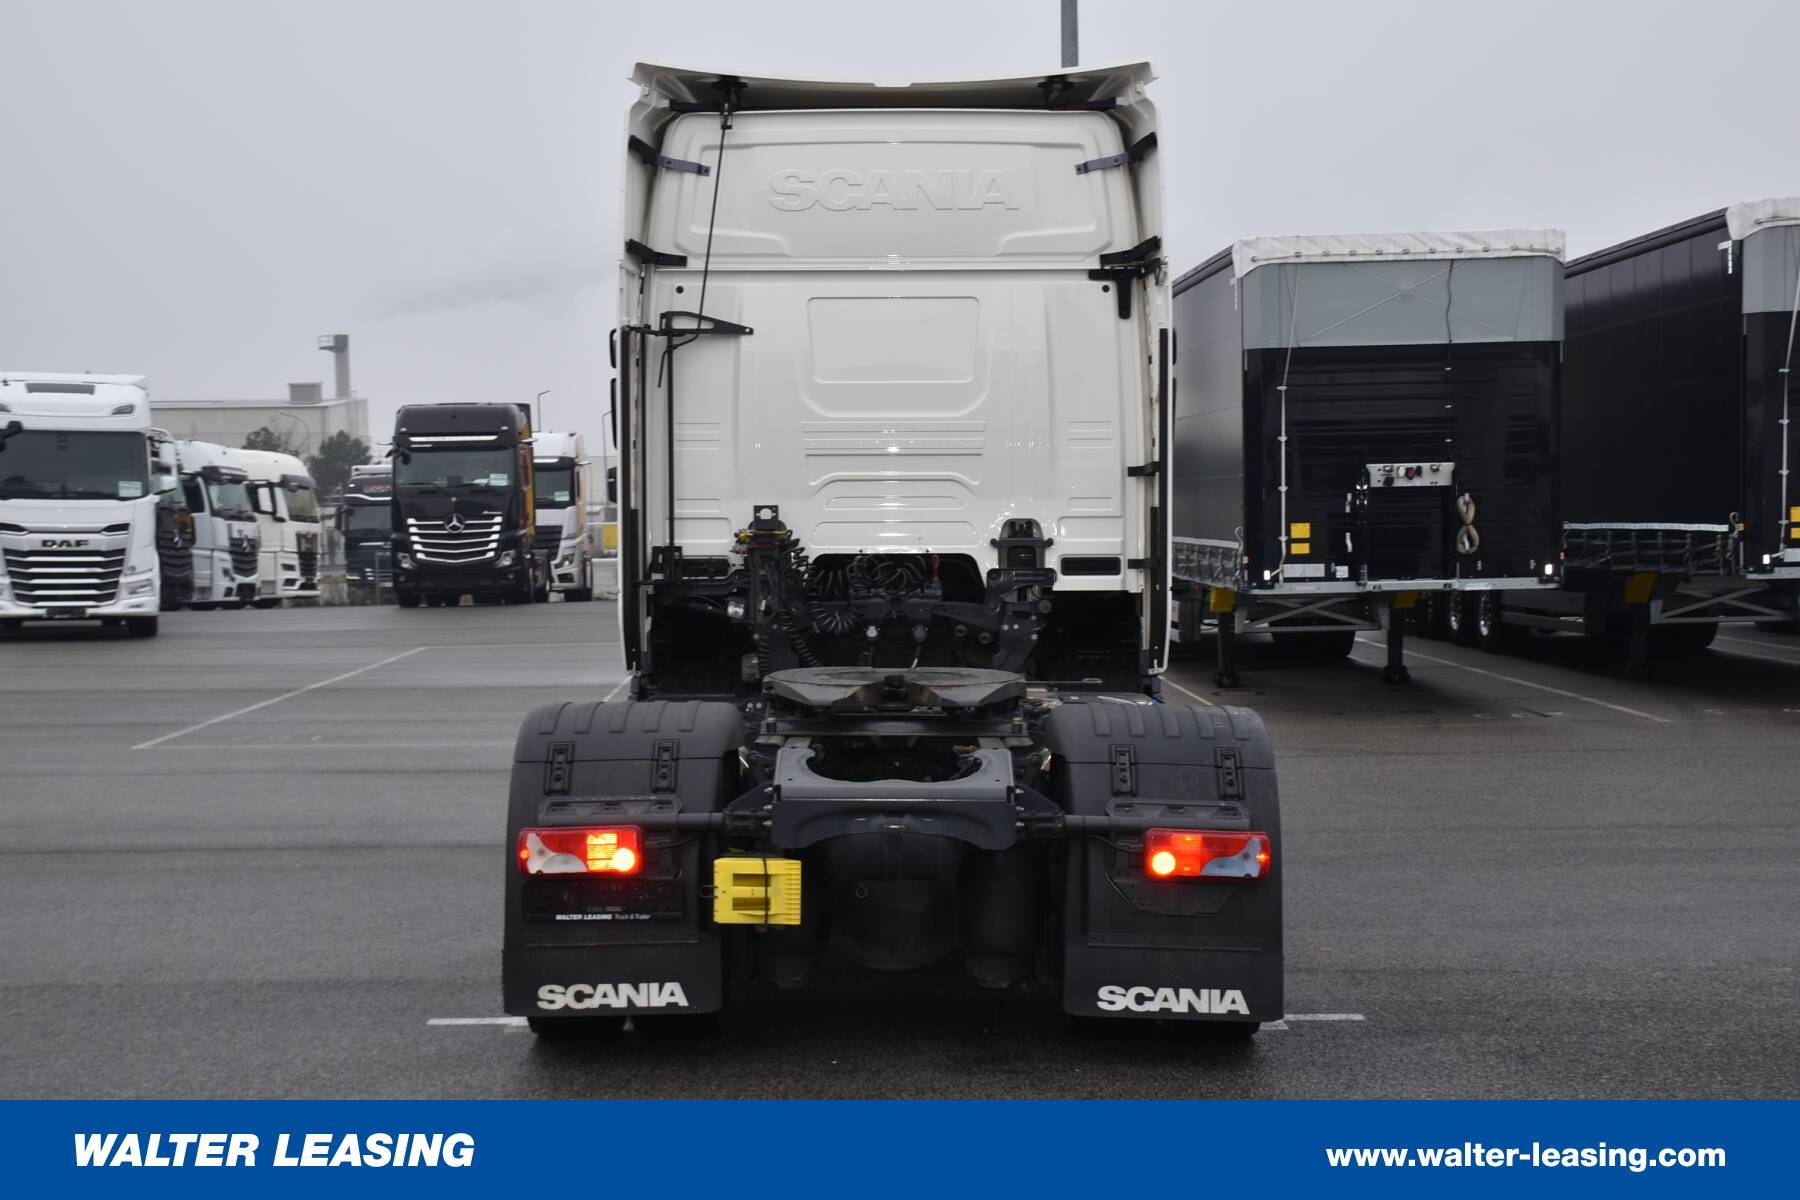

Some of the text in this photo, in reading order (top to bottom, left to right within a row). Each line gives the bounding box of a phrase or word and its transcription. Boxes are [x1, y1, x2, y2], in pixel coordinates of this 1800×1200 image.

[769, 168, 1020, 212] SCANIA
[41, 539, 90, 548] DAF
[536, 981, 690, 1010] SCANIA
[1097, 985, 1251, 1015] SCANIA
